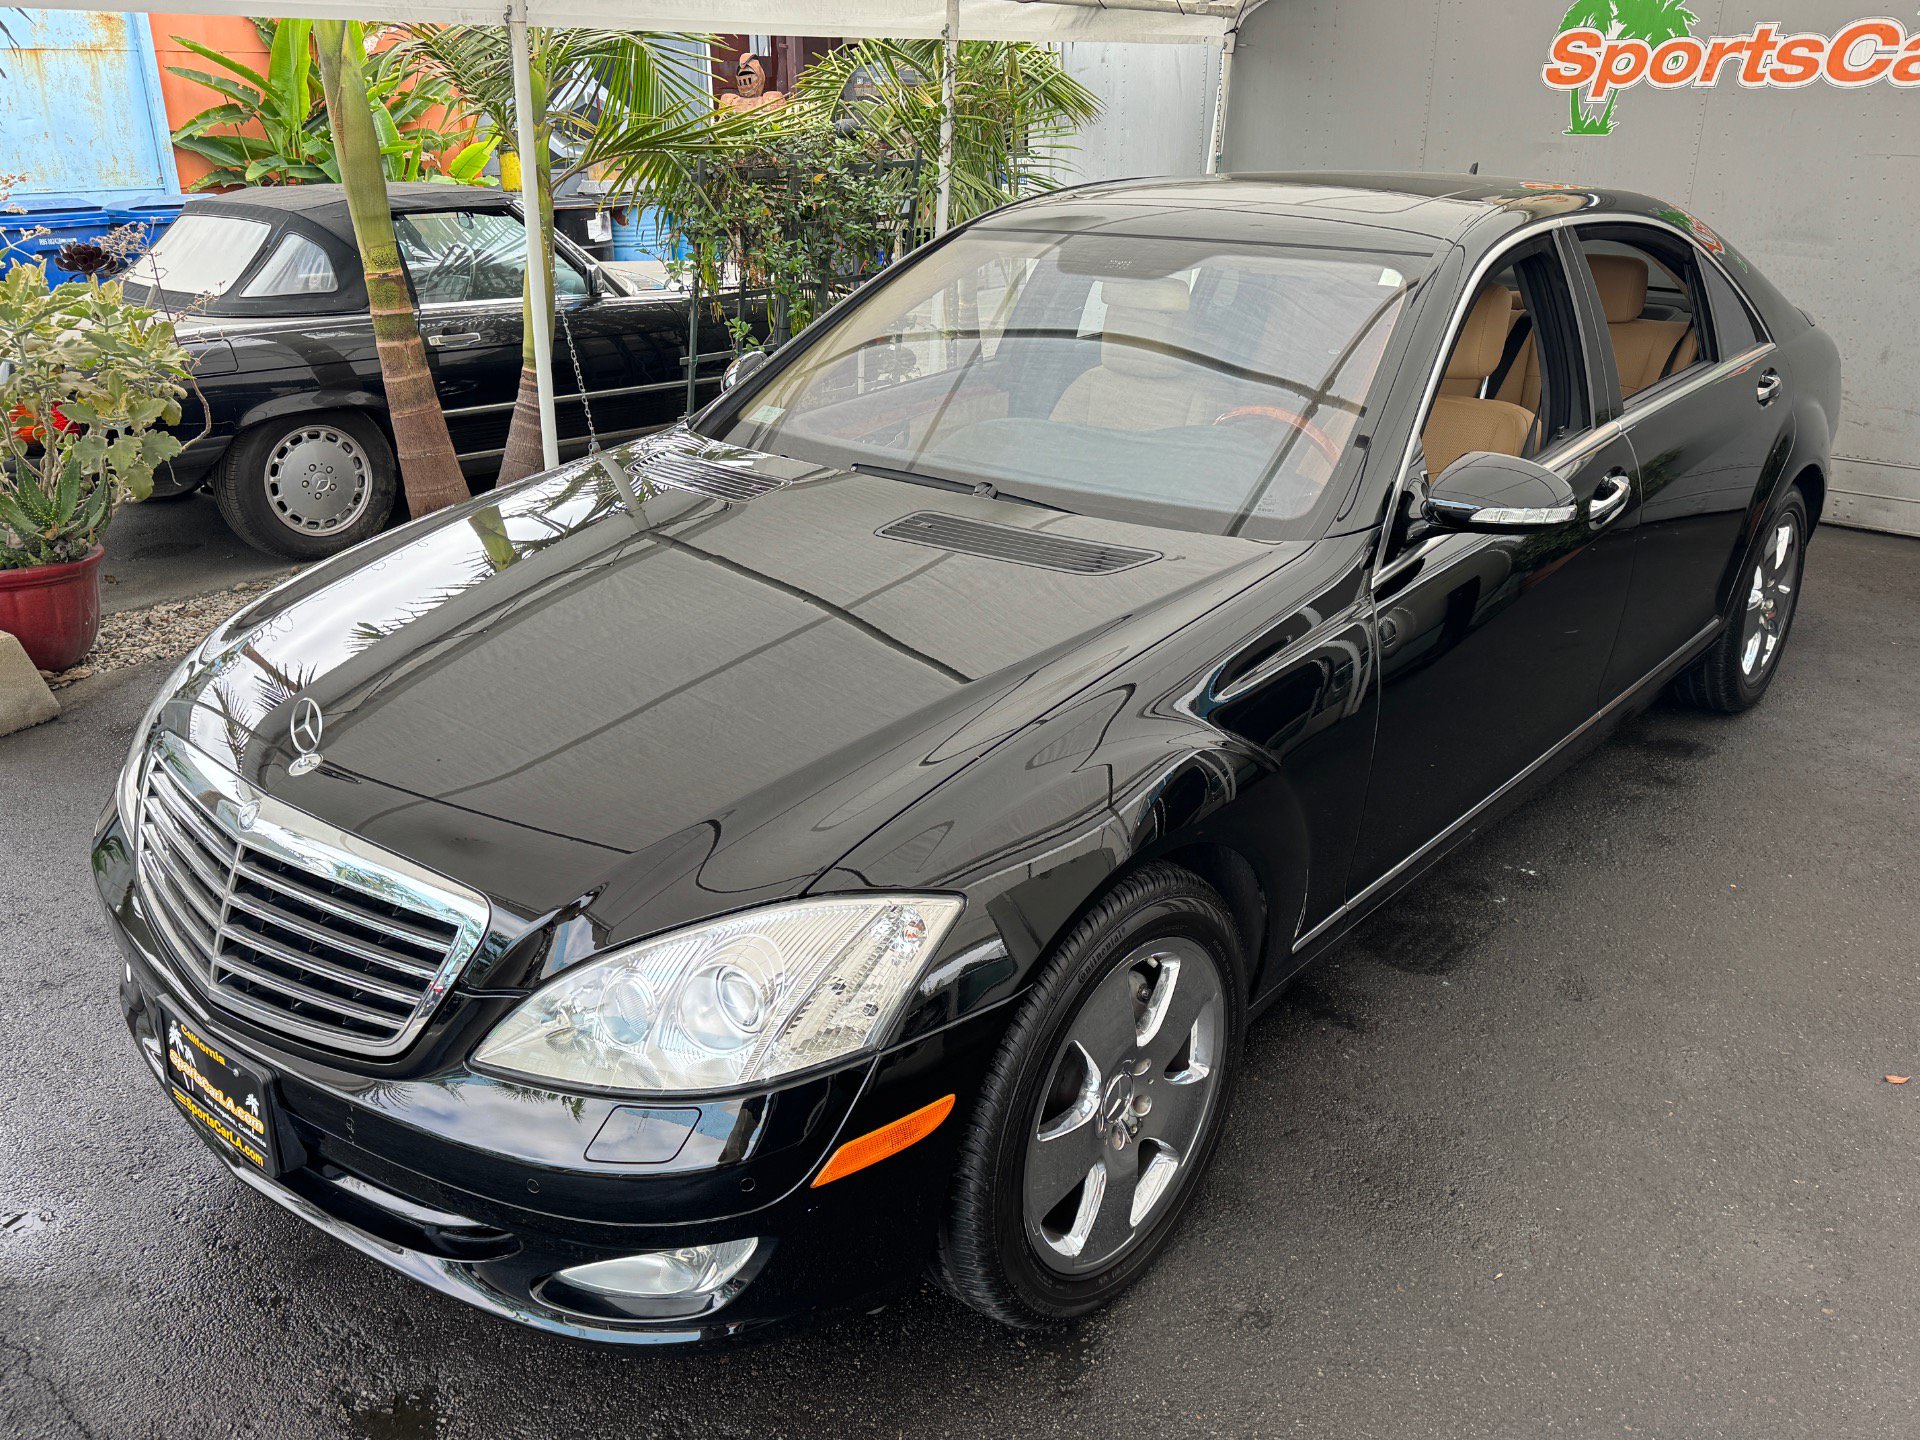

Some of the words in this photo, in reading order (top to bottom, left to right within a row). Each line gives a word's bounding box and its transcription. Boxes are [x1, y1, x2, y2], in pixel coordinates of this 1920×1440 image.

[1078, 930, 1123, 984] Continental
[181, 1024, 226, 1066] California
[169, 1049, 264, 1135] SportsCarLA.com
[186, 1097, 264, 1167] SportsCarLA.com
